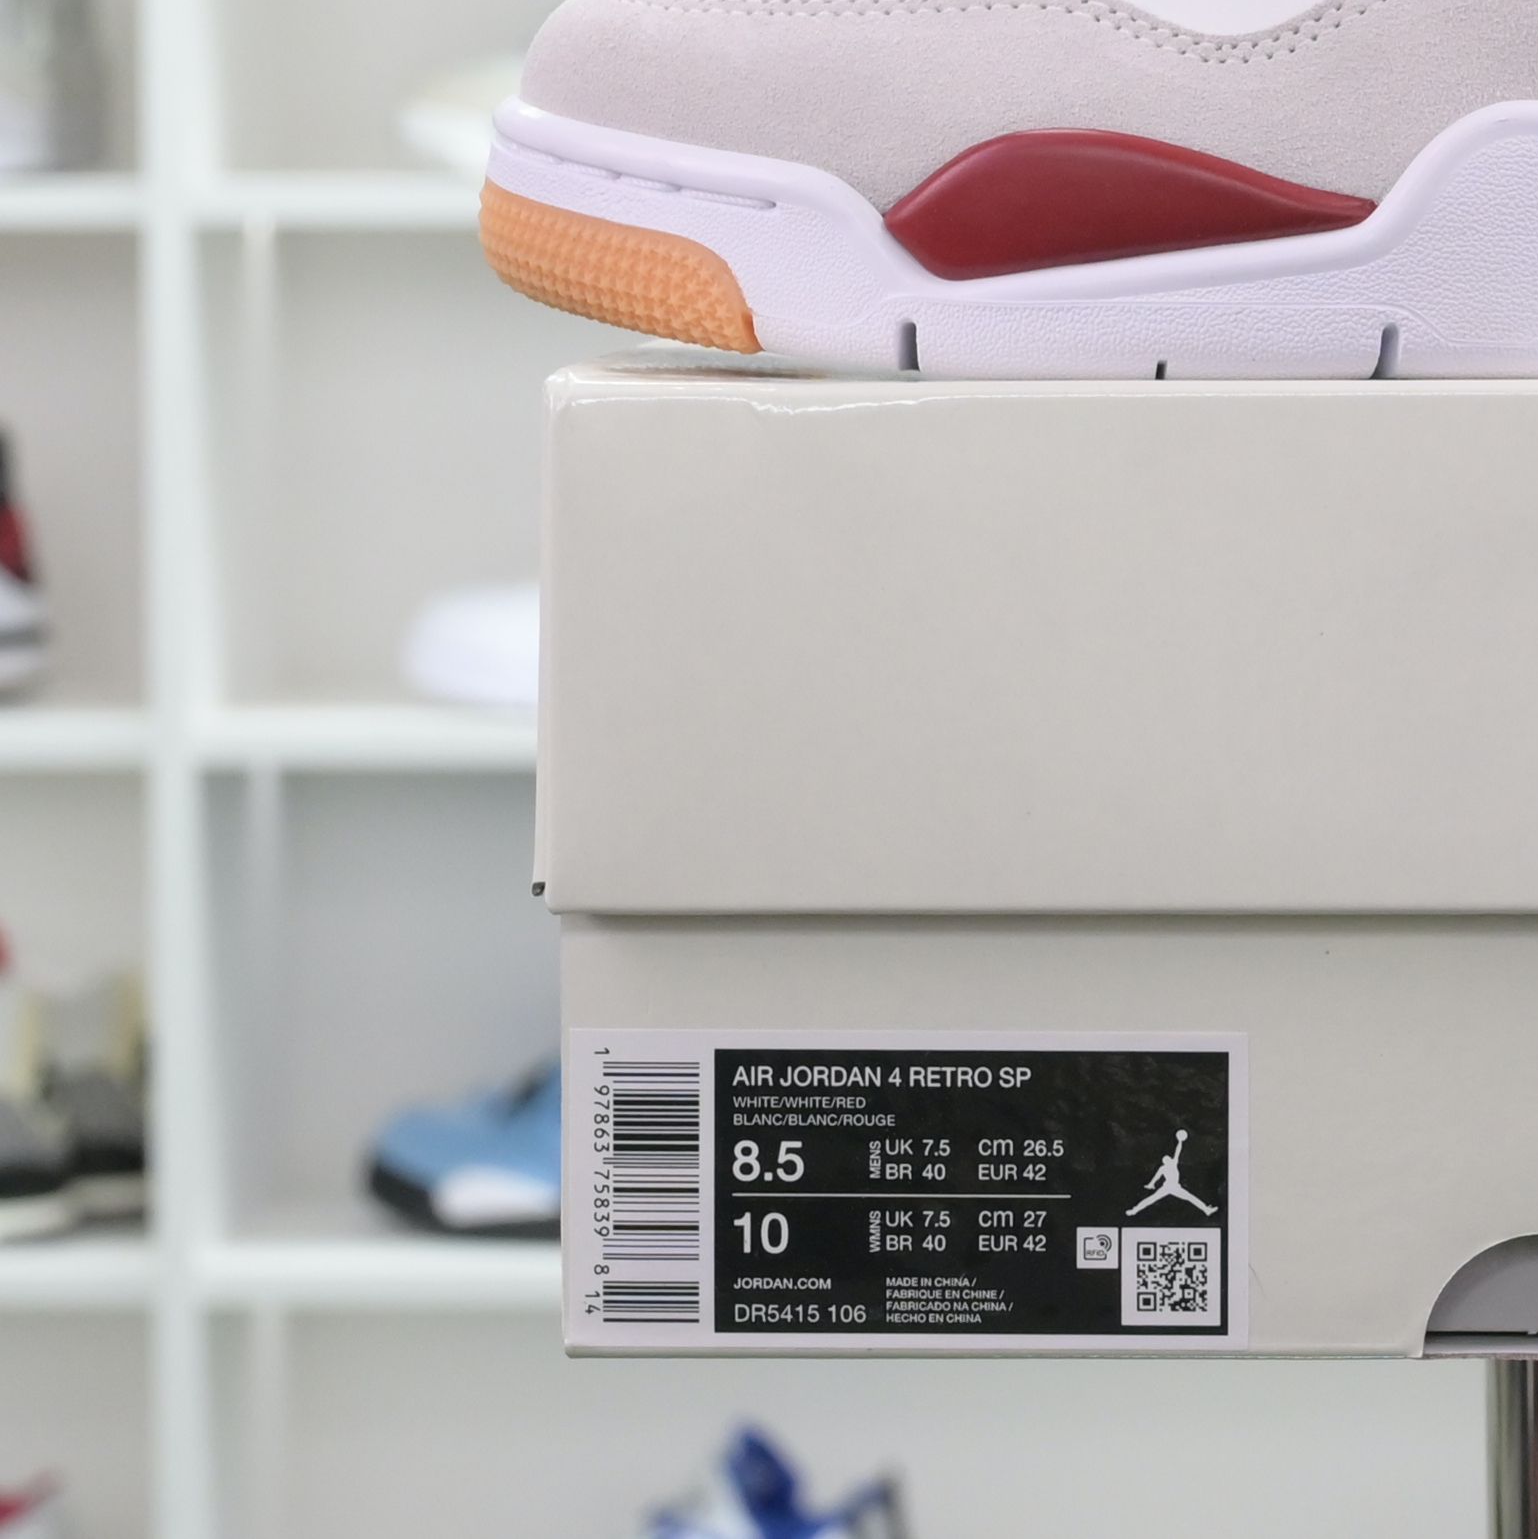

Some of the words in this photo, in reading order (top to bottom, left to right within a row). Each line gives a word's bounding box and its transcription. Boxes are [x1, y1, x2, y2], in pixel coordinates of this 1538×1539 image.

[733, 1066, 773, 1086] AIR
[780, 1066, 881, 1087] JORDAN
[888, 1067, 901, 1087] 4
[910, 1067, 992, 1088] RETRO
[999, 1067, 1031, 1088] SP
[733, 1096, 866, 1108] WHITE/WHITE/RED
[594, 1085, 610, 1152] 97863
[734, 1114, 895, 1126] BLANC/BLANC/ROUGE
[886, 1139, 913, 1155] UK
[923, 1140, 950, 1156] 7.5
[1024, 1140, 1064, 1156] 26.5
[733, 1140, 804, 1182] 8.5
[869, 1141, 881, 1178] MENS
[886, 1164, 912, 1179] BR
[922, 1164, 945, 1180] 40
[979, 1164, 1017, 1180] EUR
[1023, 1164, 1046, 1180] 42
[594, 1170, 609, 1237] 75839
[886, 1211, 913, 1227] UK
[923, 1211, 950, 1227] 7.5
[1024, 1211, 1046, 1227] 27
[734, 1212, 788, 1254] 10
[869, 1211, 881, 1252] WMNS
[886, 1235, 912, 1251] BR
[923, 1235, 946, 1251] 40
[979, 1235, 1017, 1251] EUR
[1023, 1235, 1046, 1251] 42
[594, 1265, 609, 1275] 8
[734, 1278, 831, 1289] JORDAN.COM
[886, 1277, 918, 1286] MADE
[921, 1278, 932, 1286] IN
[934, 1277, 970, 1287] CHINA
[886, 1290, 942, 1299] FABRIQUE
[945, 1290, 960, 1299] EN
[962, 1290, 997, 1299] CHINE
[735, 1304, 819, 1322] DR5415
[828, 1305, 866, 1323] 106
[886, 1301, 951, 1311] FABRICADO
[953, 1302, 969, 1311] NA
[971, 1302, 1006, 1311] CHINA
[886, 1313, 926, 1323] HECHO
[929, 1313, 943, 1323] EN
[946, 1314, 981, 1323] CHINA
